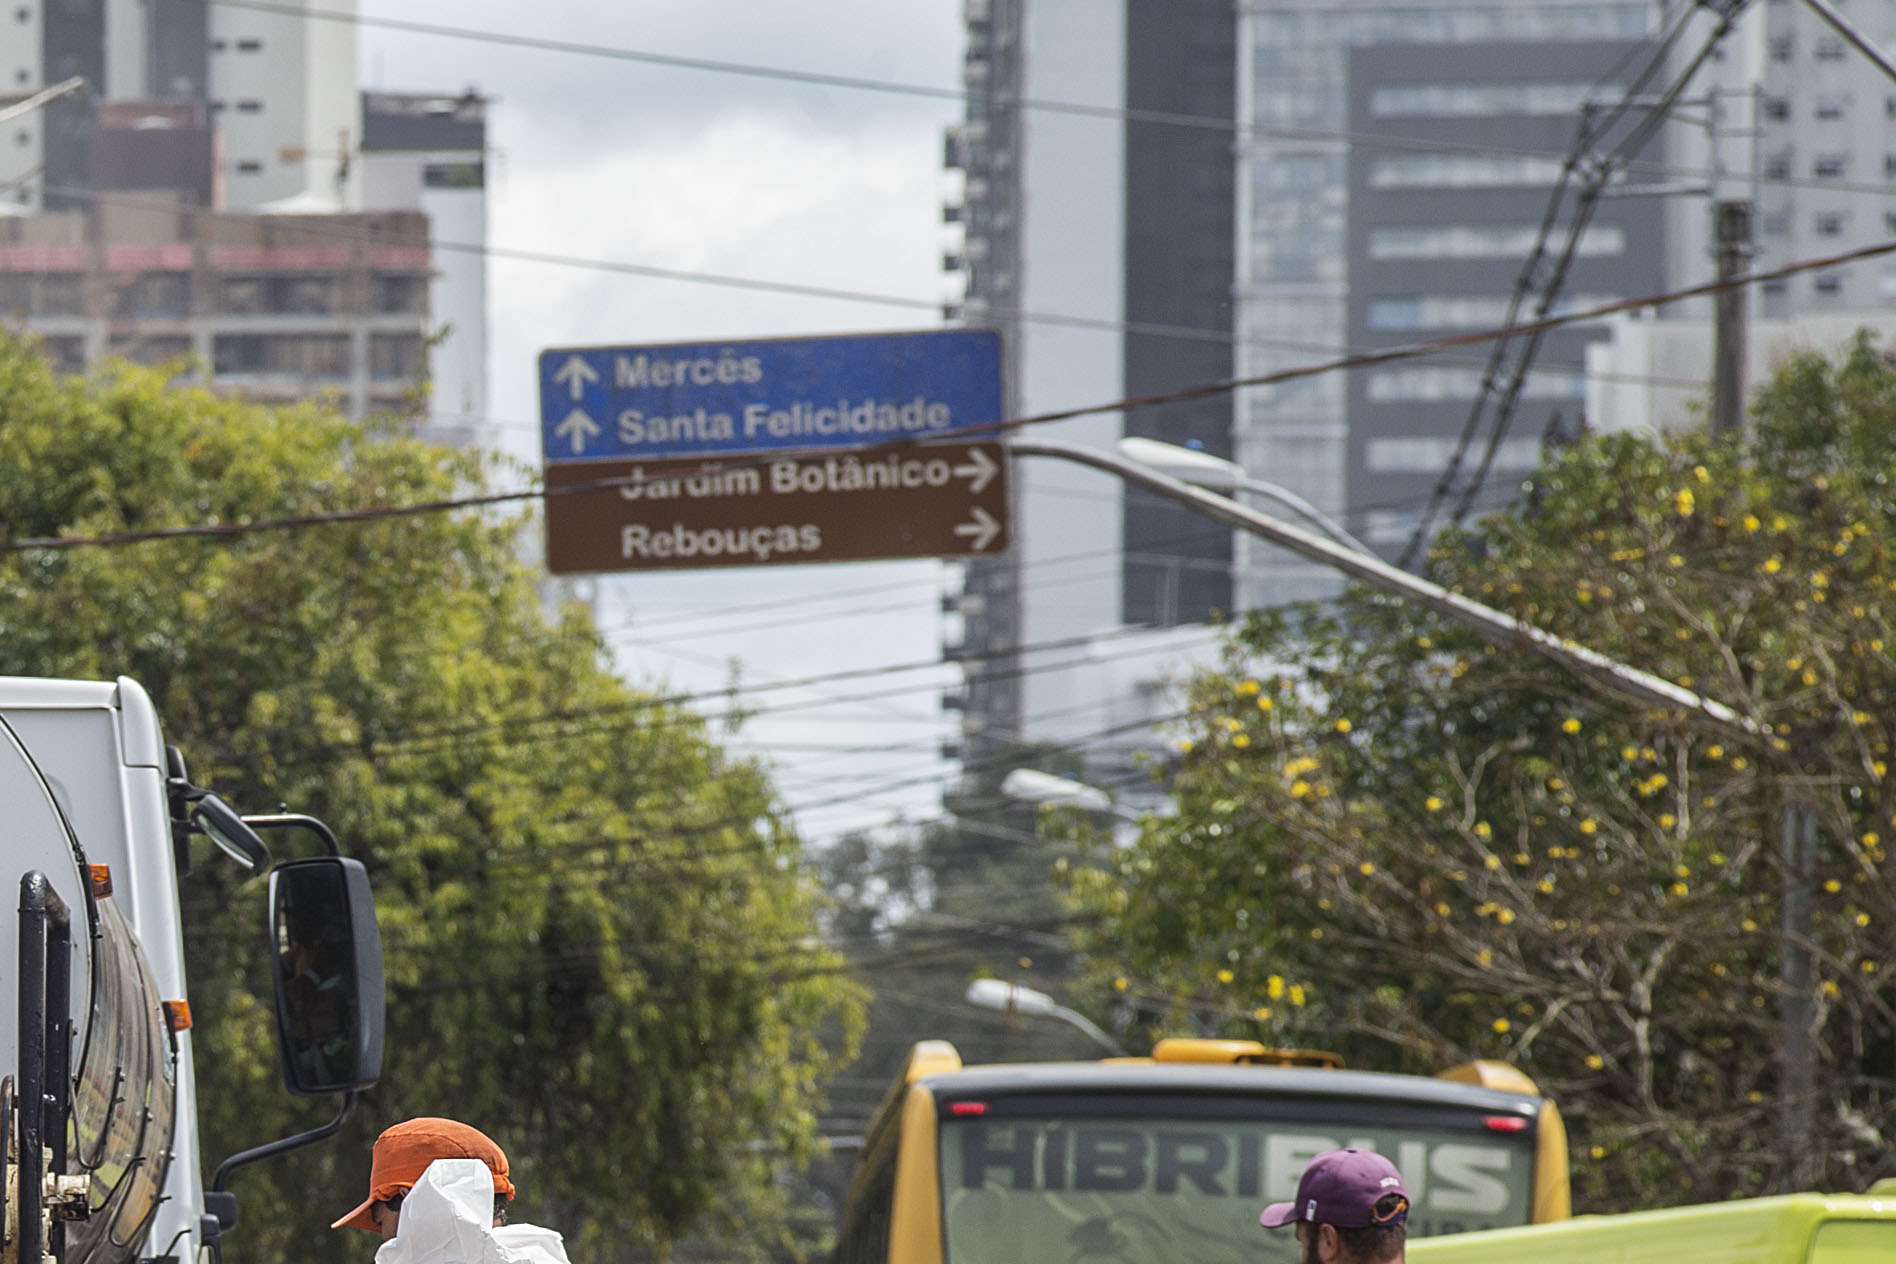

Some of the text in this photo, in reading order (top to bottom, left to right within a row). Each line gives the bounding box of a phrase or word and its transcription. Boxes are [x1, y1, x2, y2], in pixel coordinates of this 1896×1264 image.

[614, 348, 762, 388] Mercês
[617, 399, 952, 446] Santa Felicidade
[619, 456, 952, 500] Jardim Botânico
[621, 523, 822, 562] Rebouças
